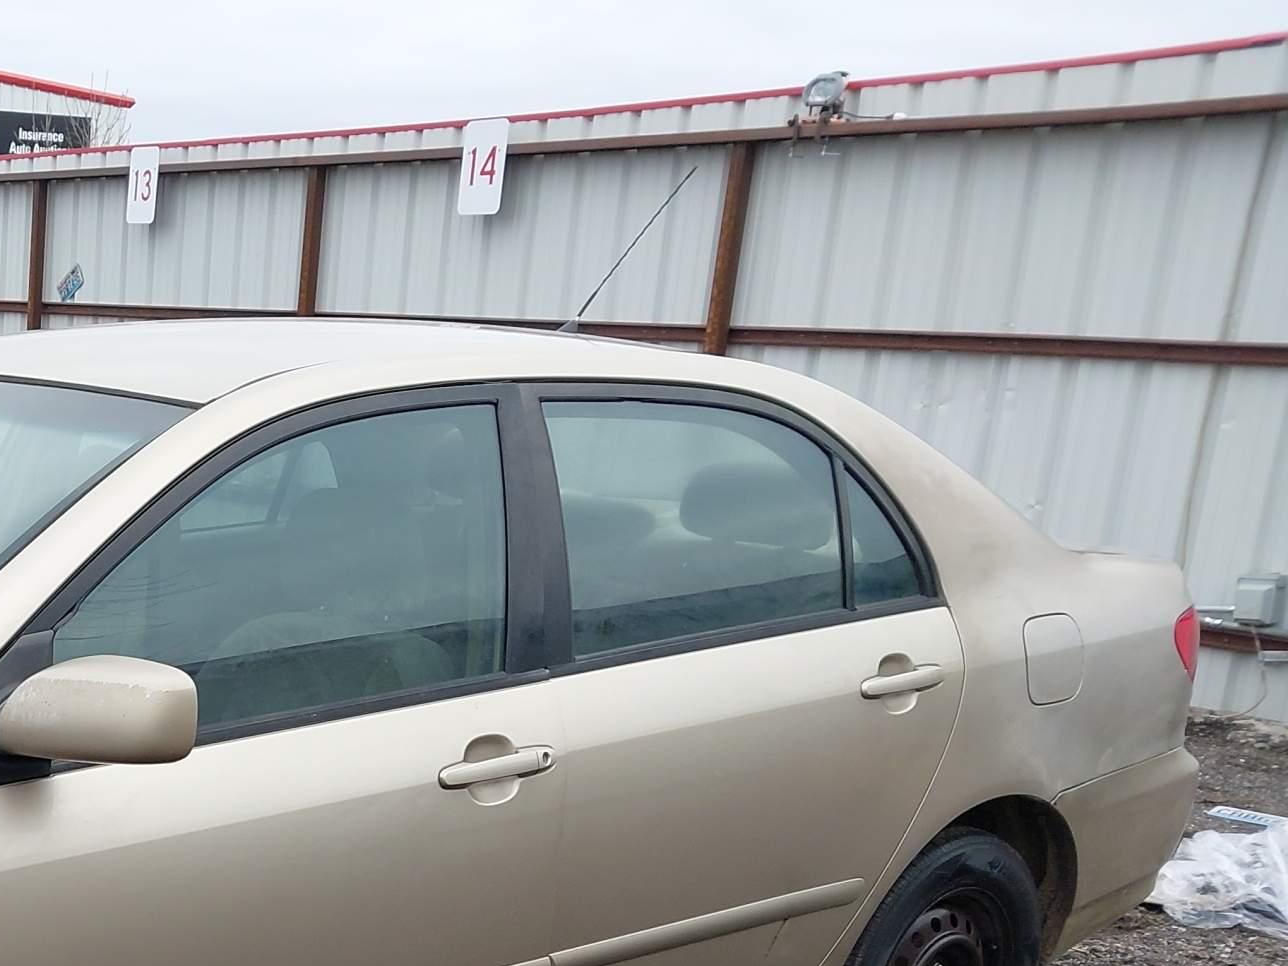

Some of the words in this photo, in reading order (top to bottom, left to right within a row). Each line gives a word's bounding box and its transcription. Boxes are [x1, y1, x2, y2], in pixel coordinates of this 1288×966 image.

[9, 141, 30, 154] Auto
[19, 127, 64, 146] Insurance
[469, 145, 497, 186] 14
[133, 169, 152, 201] 13
